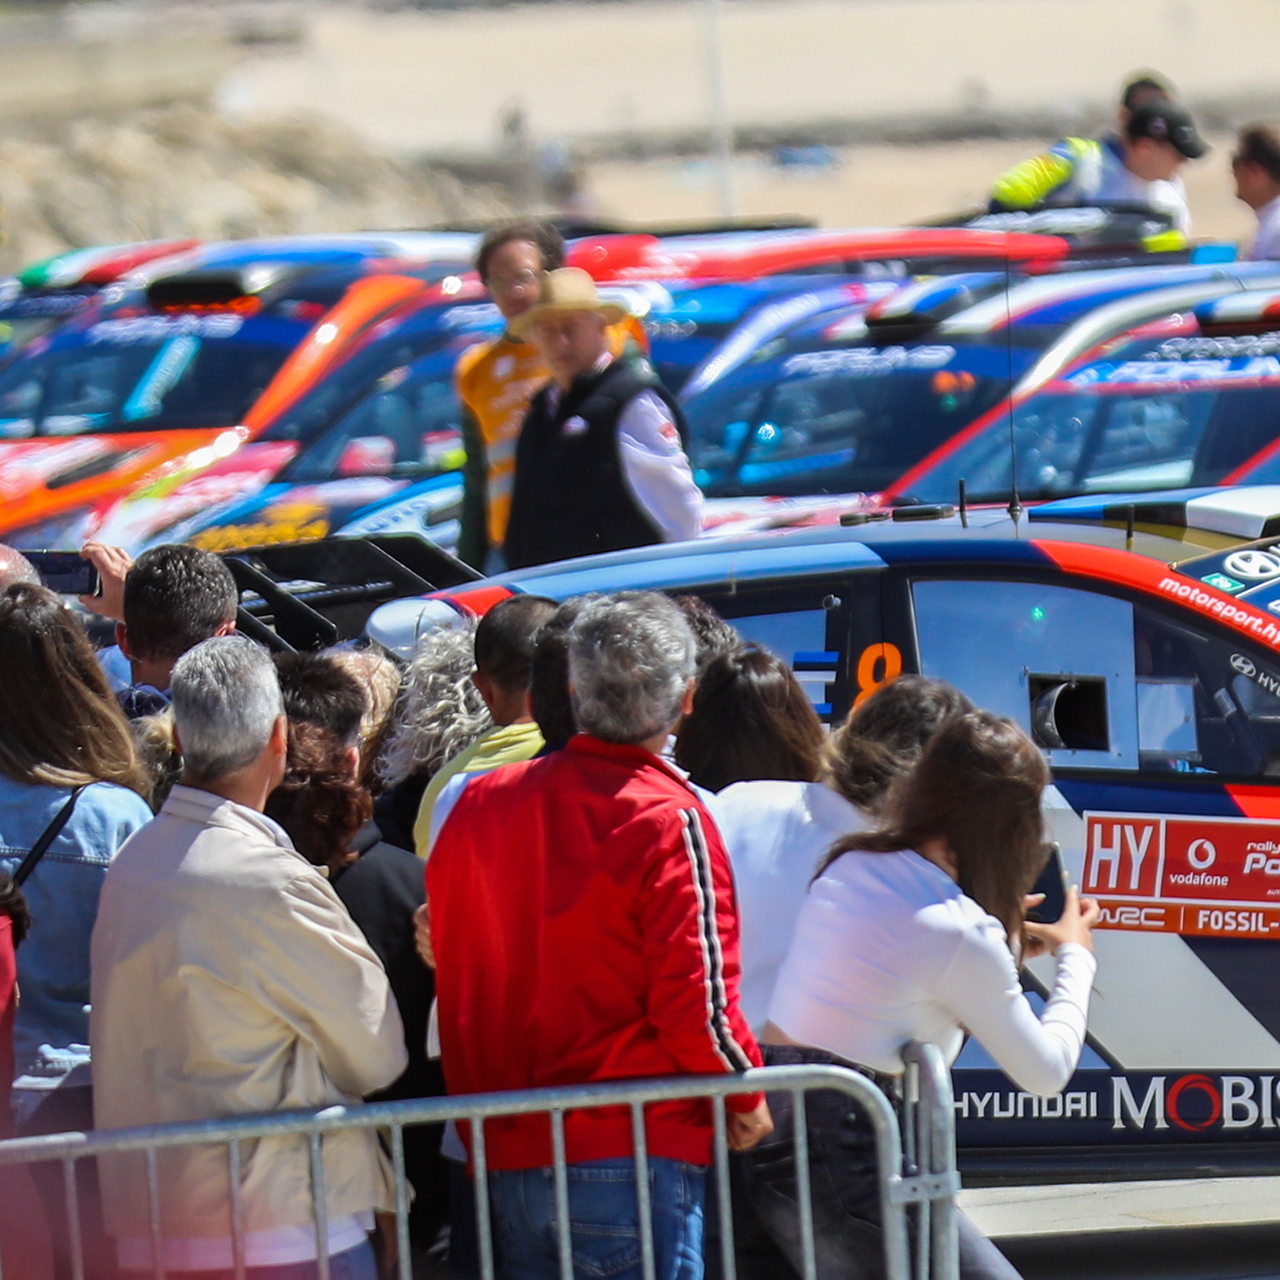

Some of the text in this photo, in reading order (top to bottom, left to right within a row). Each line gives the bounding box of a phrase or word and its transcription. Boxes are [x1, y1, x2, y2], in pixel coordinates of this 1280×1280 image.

[1088, 822, 1154, 890] HY
[1169, 871, 1229, 888] vodafone
[954, 1090, 1098, 1119] HYUNDAI
